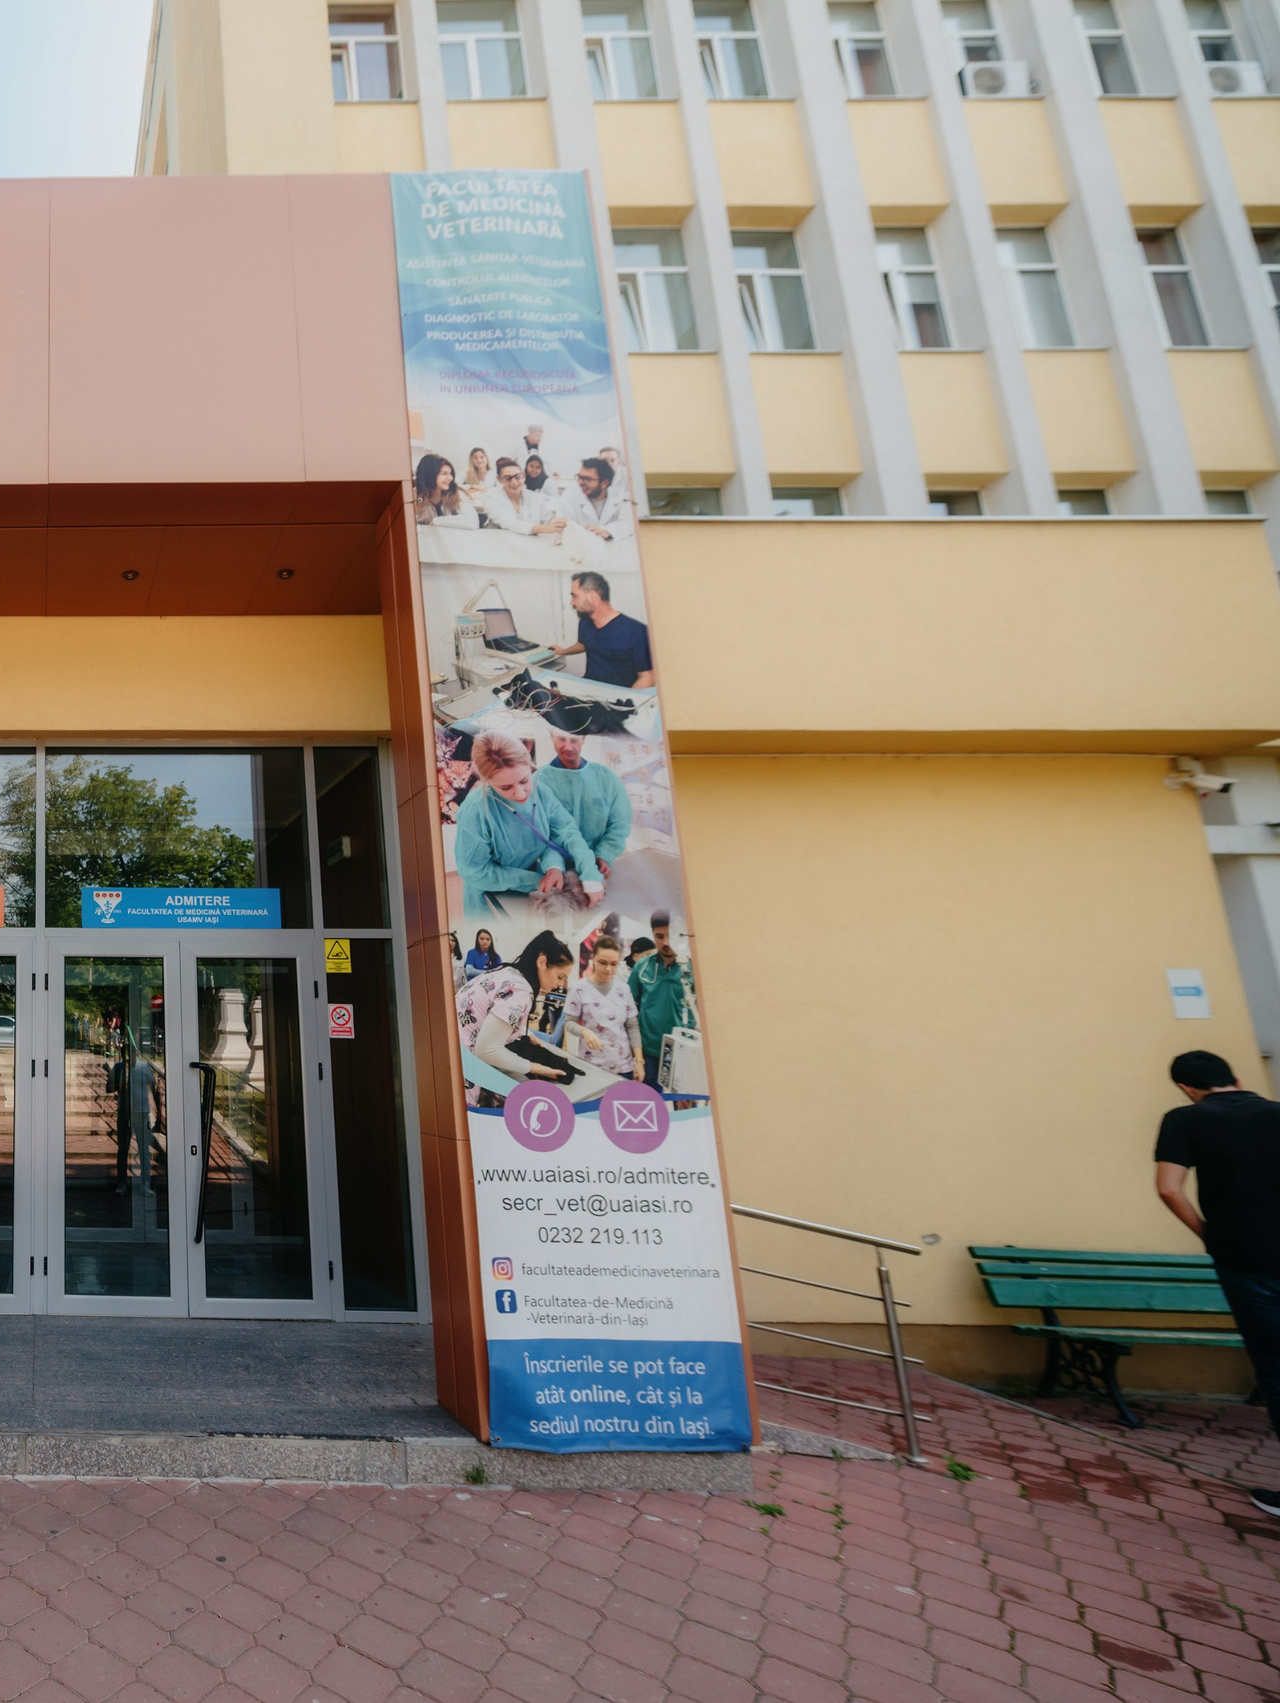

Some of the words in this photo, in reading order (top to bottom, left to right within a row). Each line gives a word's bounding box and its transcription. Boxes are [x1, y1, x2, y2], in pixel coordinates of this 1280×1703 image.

[426, 178, 558, 199] FACULTATEA
[421, 202, 451, 219] DE
[457, 196, 566, 218] MEDICINĂ
[426, 216, 564, 240] VETERINARĂ
[424, 311, 495, 323] DIAGNOSTIC
[498, 310, 514, 320] DE
[516, 311, 580, 322] LABORATOR
[426, 329, 503, 340] PRODUCEREA
[455, 339, 560, 352] MEDICAMENTELOR
[455, 384, 508, 393] UNIUNEA
[165, 896, 230, 906] ADMITERE
[222, 908, 268, 916] VETERINARĂ
[481, 1166, 710, 1185] www.uaiasi.ro/admitere
[502, 1194, 693, 1217] secr_vet@uaiasi.ro
[538, 1226, 584, 1244] 0232
[590, 1227, 663, 1245] 219.113
[521, 1263, 720, 1279] facultateademedicinaveterinara
[524, 1295, 674, 1310] Facultatea-de-Medicină
[524, 1352, 604, 1374] Înscrierile
[608, 1360, 629, 1374] se
[633, 1358, 665, 1379] pot
[669, 1356, 706, 1375] face
[535, 1385, 566, 1405] atât
[570, 1384, 631, 1406] online,
[636, 1385, 664, 1405] cât
[686, 1386, 703, 1405] la
[529, 1414, 579, 1435] sediul
[584, 1416, 639, 1433] nostru
[644, 1415, 675, 1434] din
